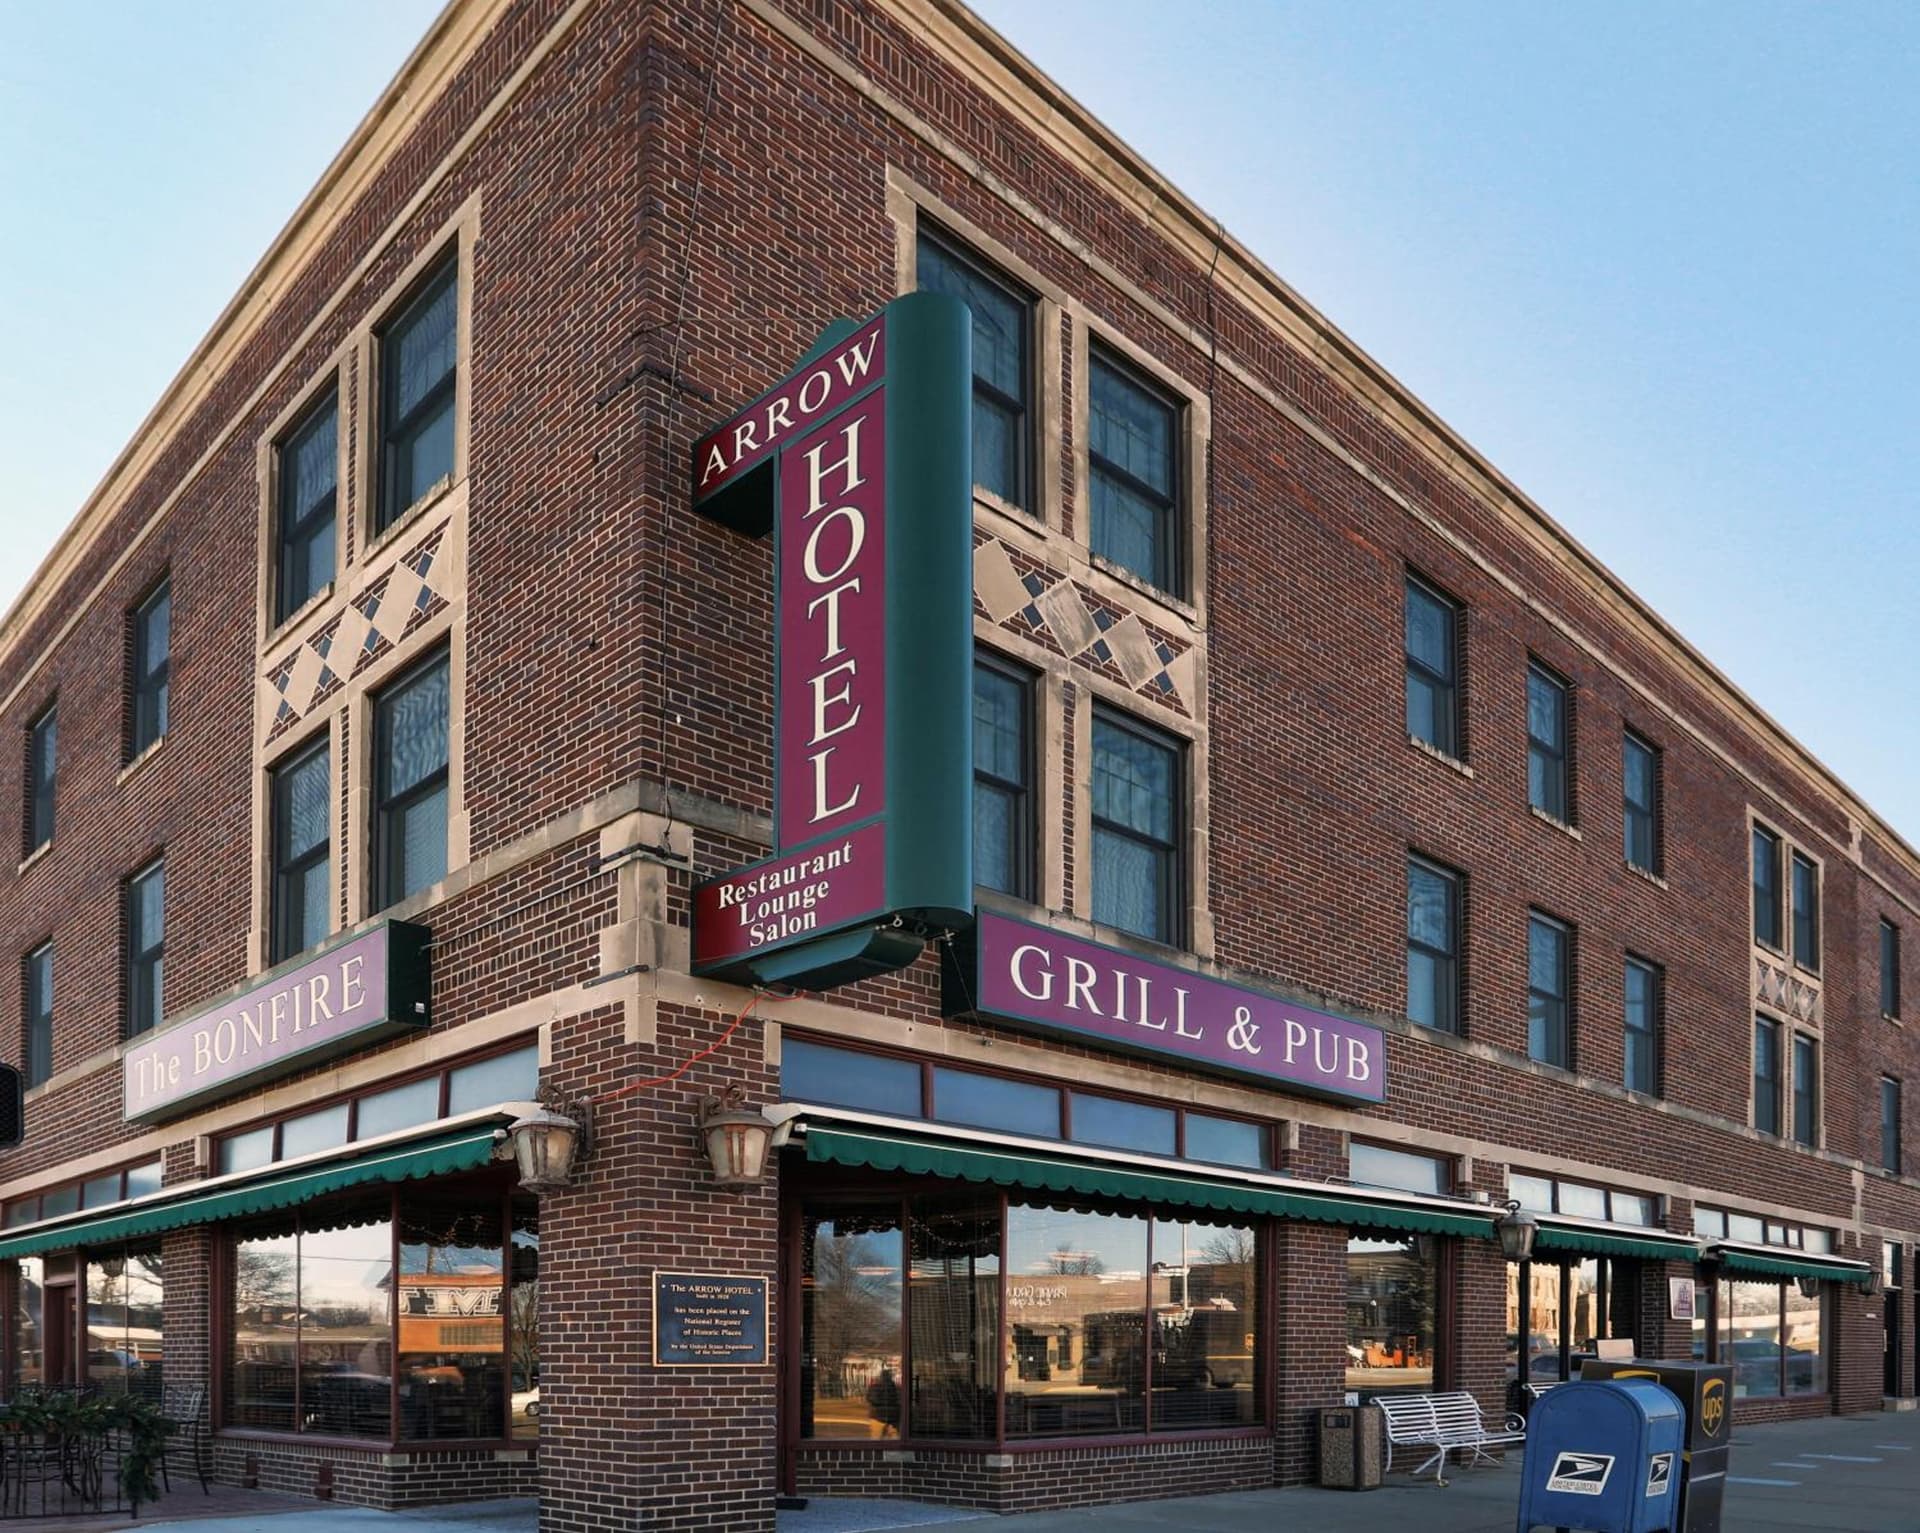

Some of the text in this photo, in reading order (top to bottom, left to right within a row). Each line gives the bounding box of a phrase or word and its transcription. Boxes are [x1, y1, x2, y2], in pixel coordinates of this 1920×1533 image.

[701, 329, 880, 486] ARROW
[802, 415, 867, 823] HOTEL
[718, 841, 852, 909] Restaurant
[739, 880, 829, 926] Lounge
[750, 911, 817, 947] Salon
[135, 955, 367, 1098] The BONFIRE
[1010, 945, 1371, 1082] GRILL & PUB
[670, 1284, 754, 1295] The ARROW HOTEL
[1702, 1396, 1723, 1428] ups
